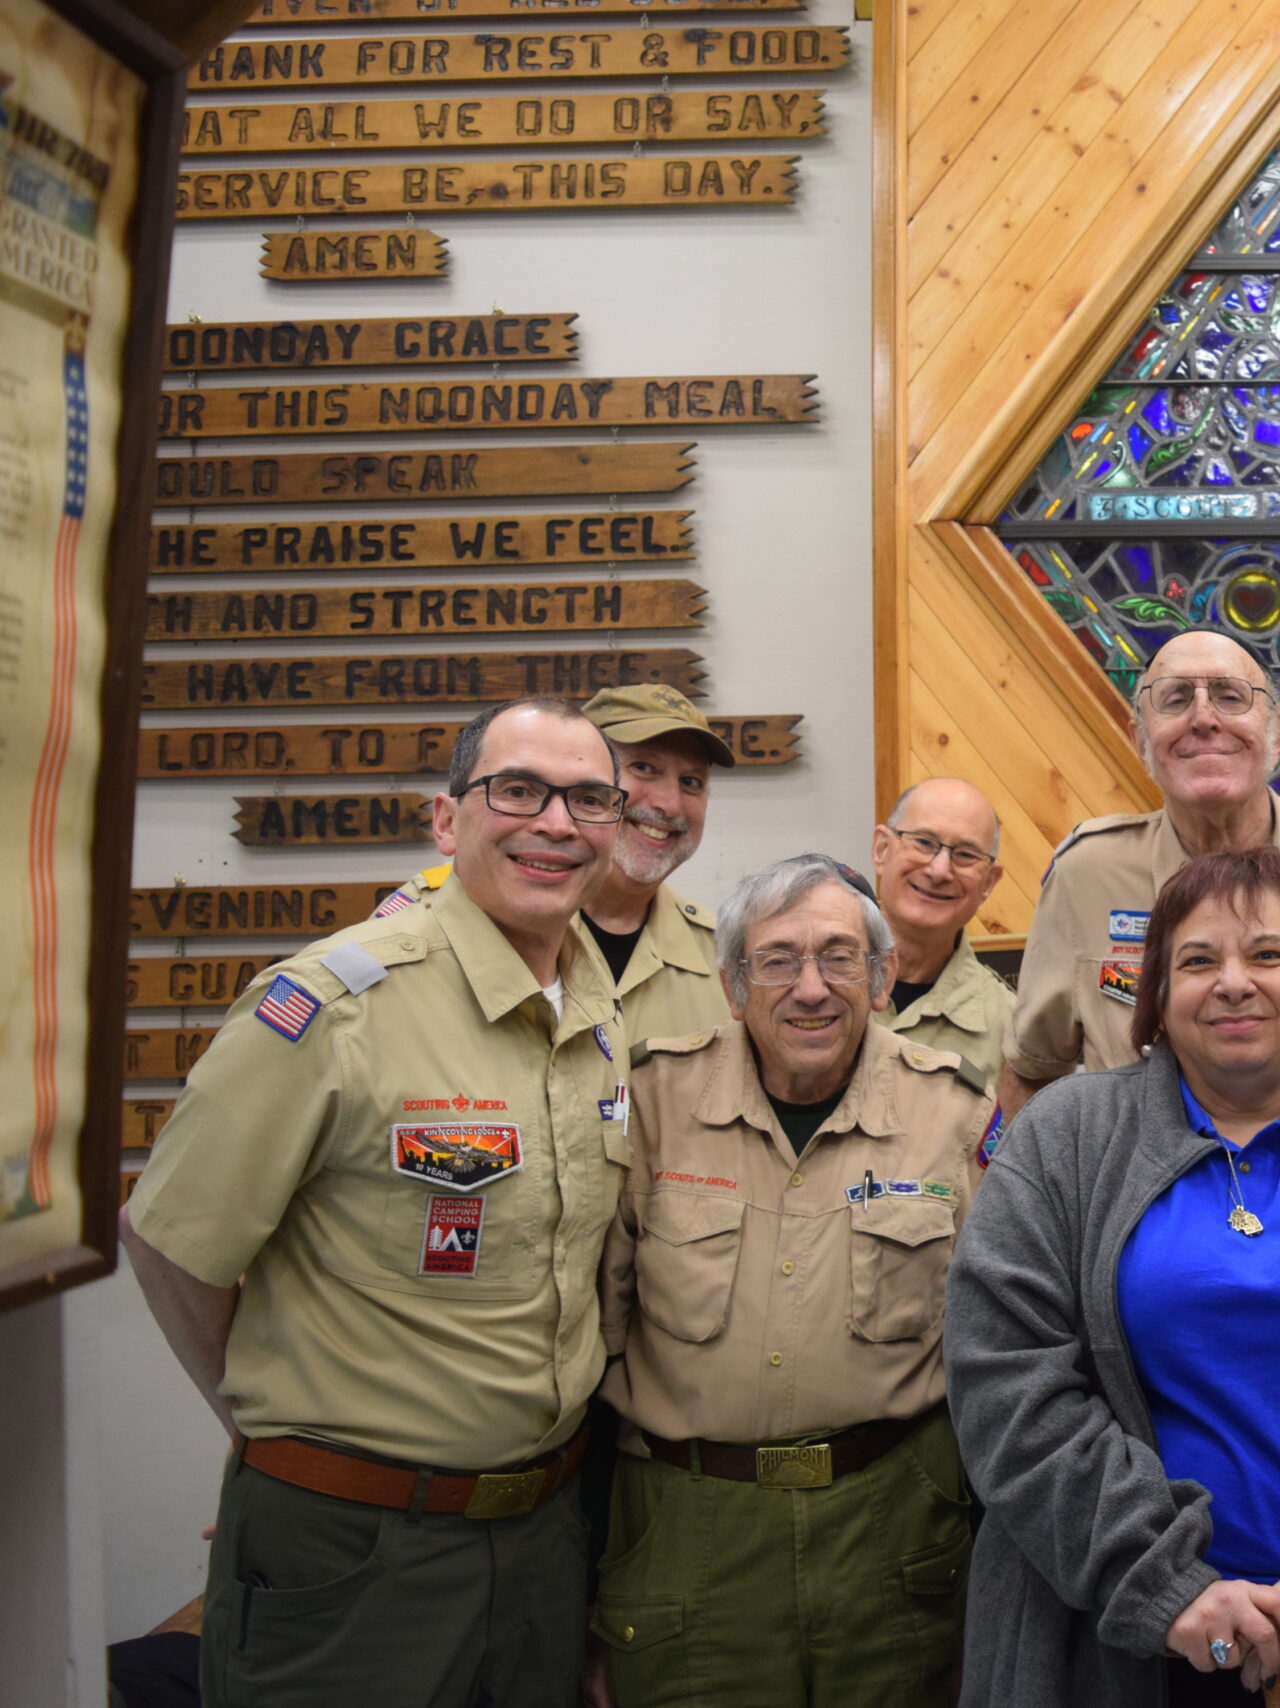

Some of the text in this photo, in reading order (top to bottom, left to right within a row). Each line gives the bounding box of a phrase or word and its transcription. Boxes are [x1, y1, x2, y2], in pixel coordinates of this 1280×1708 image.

[356, 39, 449, 77] FOR
[483, 34, 612, 73] REST
[639, 33, 669, 68] &
[691, 30, 830, 66] FOOD.
[288, 105, 380, 142] ALL
[414, 102, 482, 139] WE
[516, 98, 575, 137] DO
[613, 95, 673, 134] OR
[706, 93, 811, 135] SAY,
[512, 162, 628, 201] THIS
[663, 159, 774, 197] DAY.
[282, 233, 417, 274] AMEN
[394, 318, 551, 359] GRACE
[238, 388, 349, 429] THIS
[378, 379, 613, 425] NOONDAY
[643, 379, 777, 419] MEAL
[320, 453, 478, 496] SPEAK
[242, 524, 416, 565] PRAISE
[450, 521, 520, 558] WE
[220, 592, 317, 634] AND
[349, 585, 622, 630] STRENGTH
[187, 661, 315, 702] HAVE
[344, 656, 483, 698] FROM
[320, 728, 385, 774] TO
[258, 797, 401, 839] AMEN
[403, 1098, 508, 1111] SCOUTING AMERICA
[425, 1166, 454, 1181] YEARS
[665, 1171, 695, 1184] SCOUTS
[432, 1214, 477, 1225] SCHOOL
[433, 1206, 479, 1216] CAMPING
[434, 1199, 480, 1208] NATIONAL
[758, 1446, 828, 1474] PHILMONT
